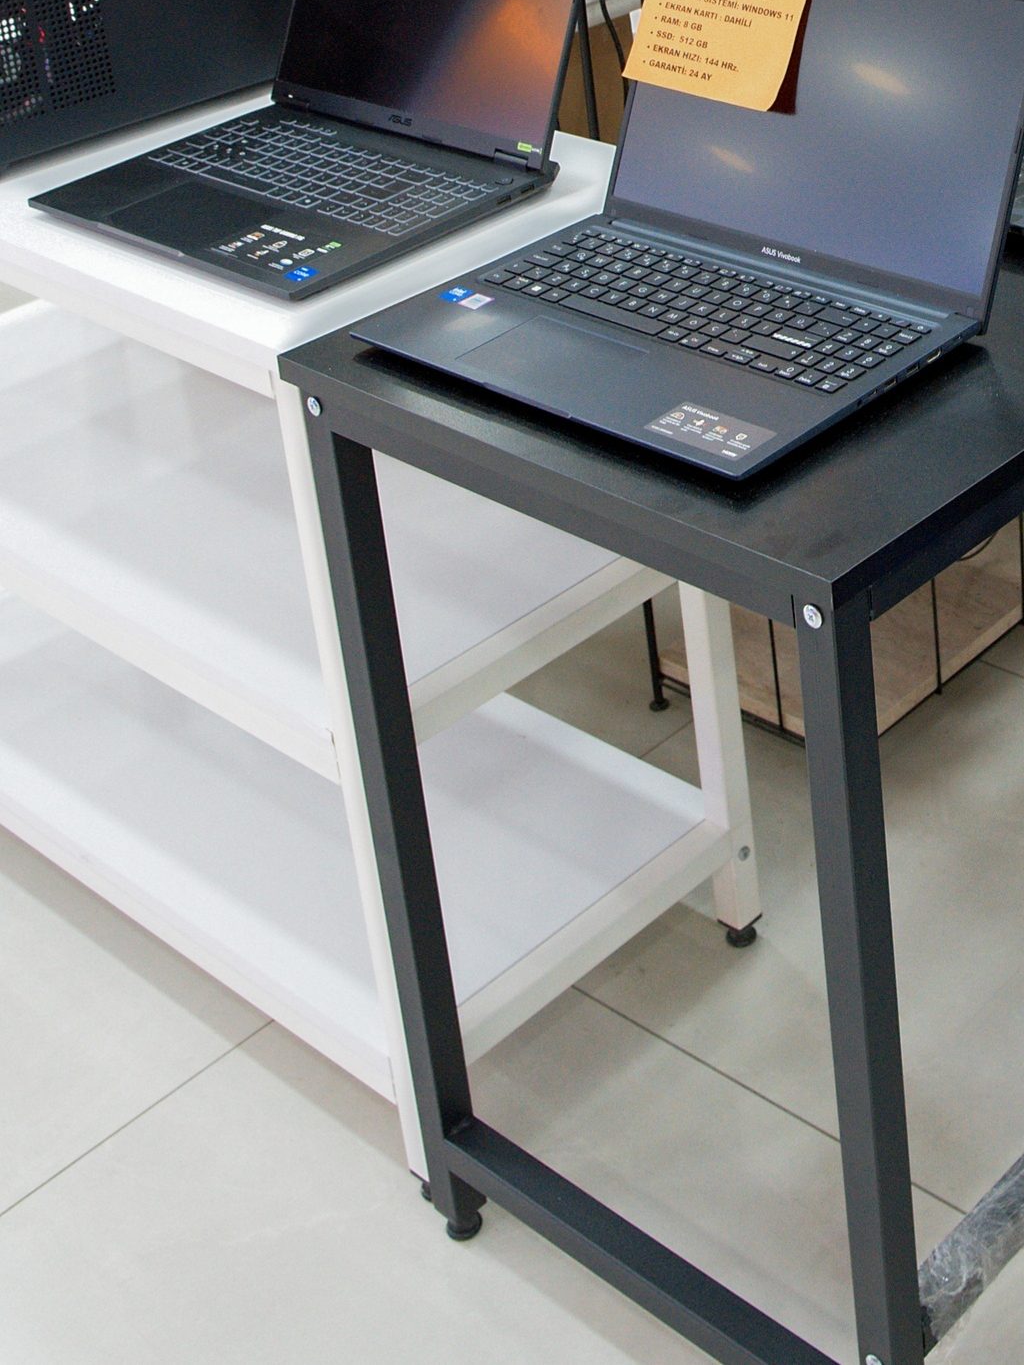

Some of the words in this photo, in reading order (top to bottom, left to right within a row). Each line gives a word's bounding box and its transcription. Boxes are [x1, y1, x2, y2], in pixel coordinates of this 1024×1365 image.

[665, 2, 692, 13] EKRAN
[694, 9, 718, 20] KARTI
[724, 15, 752, 28] DAHİLİ
[742, 3, 782, 19] WİNDOWS
[785, 13, 794, 22] 11
[660, 15, 681, 26] RAM:
[691, 22, 702, 31] GB
[656, 30, 675, 40] SSD:
[679, 36, 694, 45] 512
[696, 40, 708, 48] GB
[653, 44, 680, 57] EKRAN
[682, 51, 702, 62] HIZI:
[705, 57, 719, 66] 144
[721, 61, 739, 72] HRz.
[649, 59, 687, 74] GARANTİ:
[688, 69, 699, 78] 24
[700, 72, 713, 81] AY
[761, 246, 776, 257] ASUS
[777, 250, 801, 263] Vivobook
